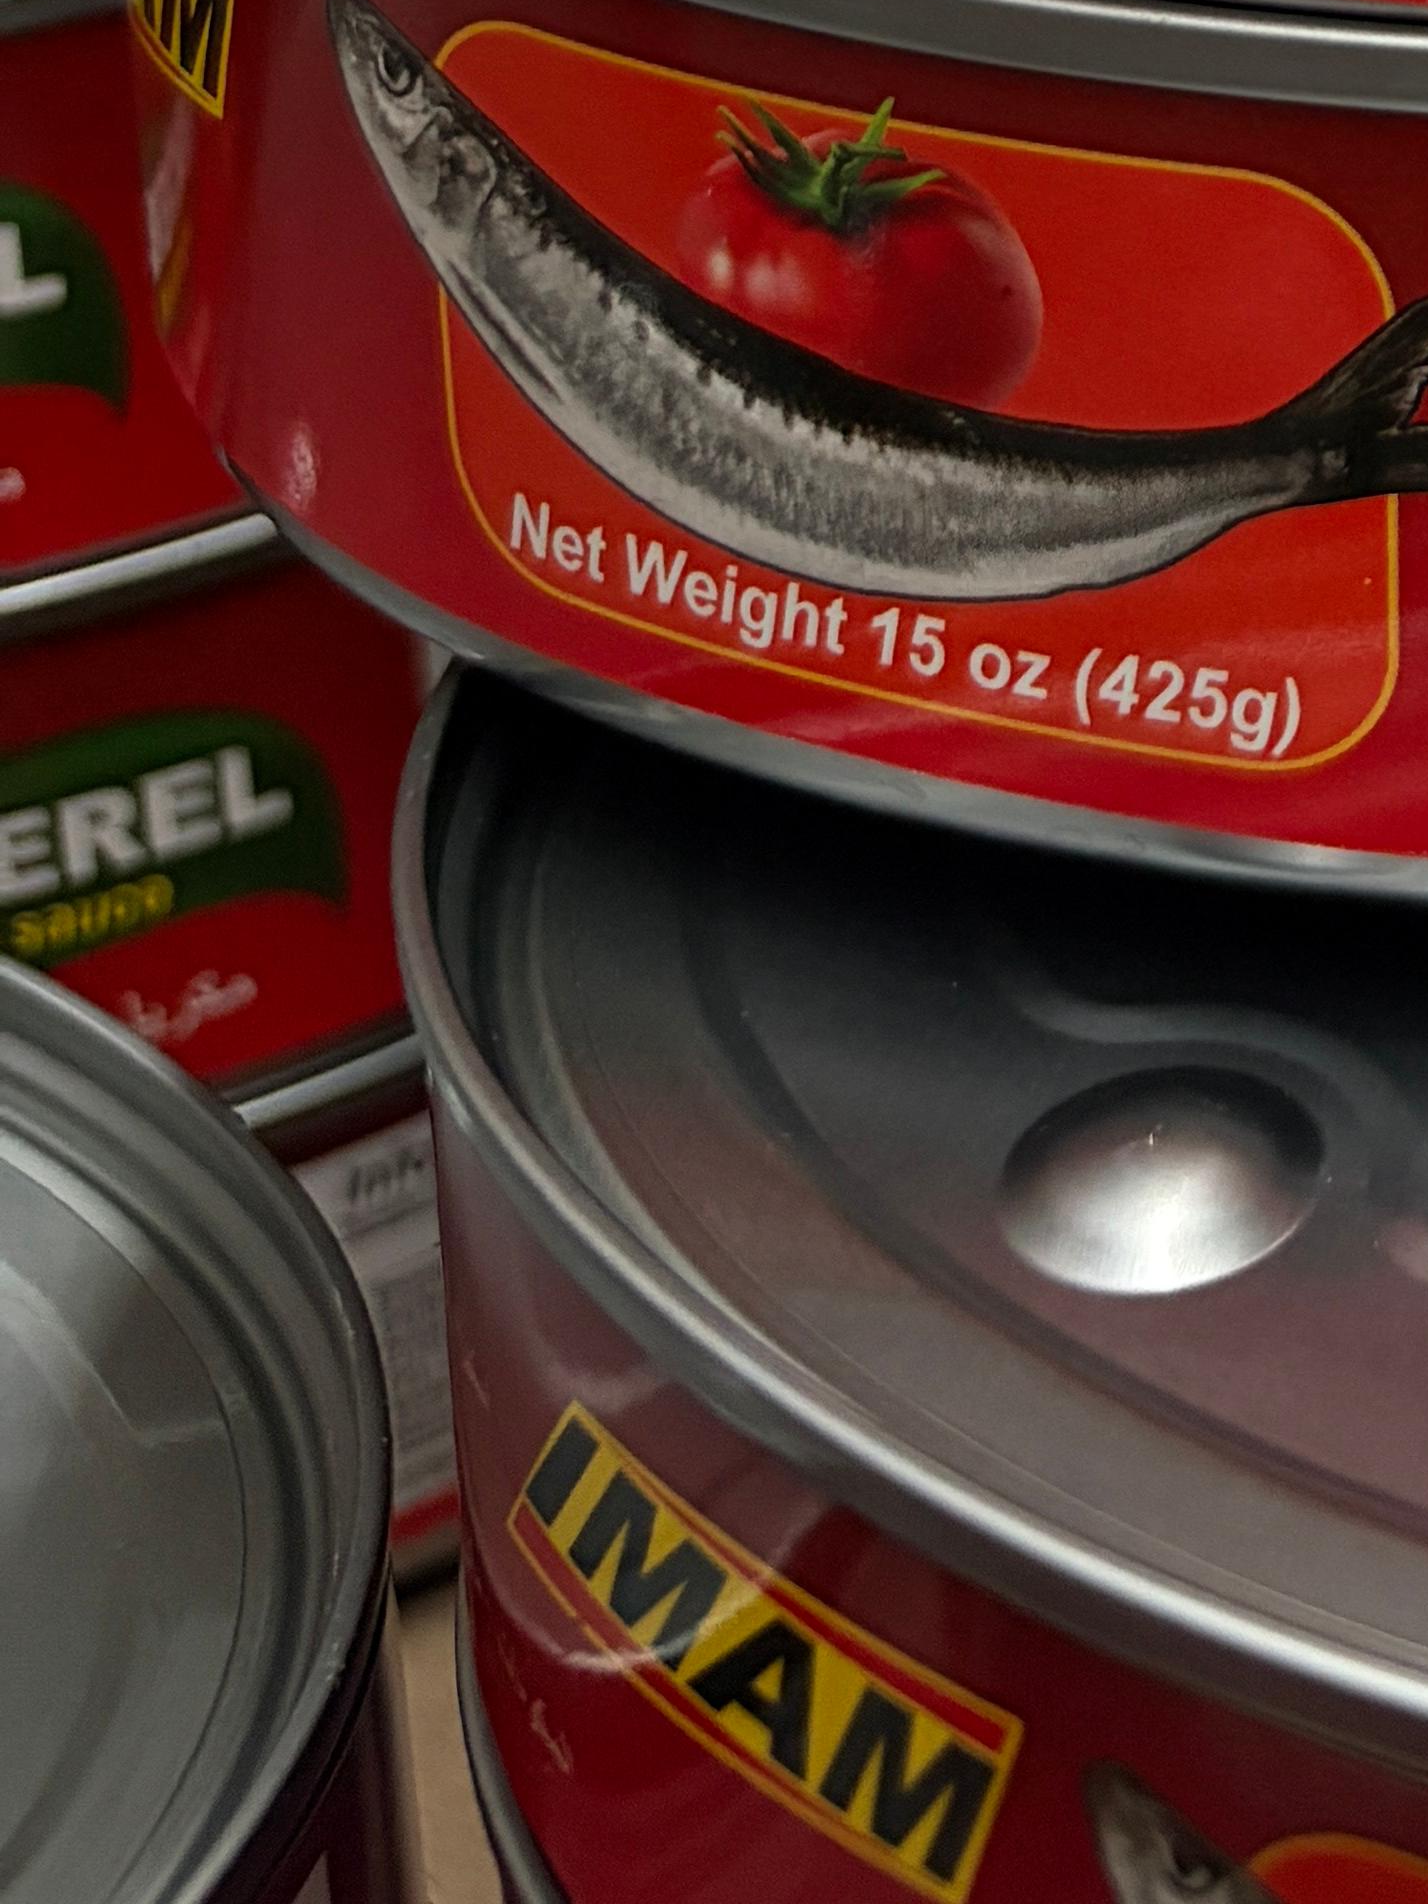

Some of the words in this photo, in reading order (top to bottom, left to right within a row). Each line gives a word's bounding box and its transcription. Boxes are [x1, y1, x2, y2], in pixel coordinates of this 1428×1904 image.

[509, 492, 607, 583] Net
[624, 532, 848, 655] Weight
[871, 606, 947, 677] 15
[968, 641, 1051, 700] oz
[1074, 647, 1302, 758] (425g)
[524, 1419, 998, 1886] IMAM
